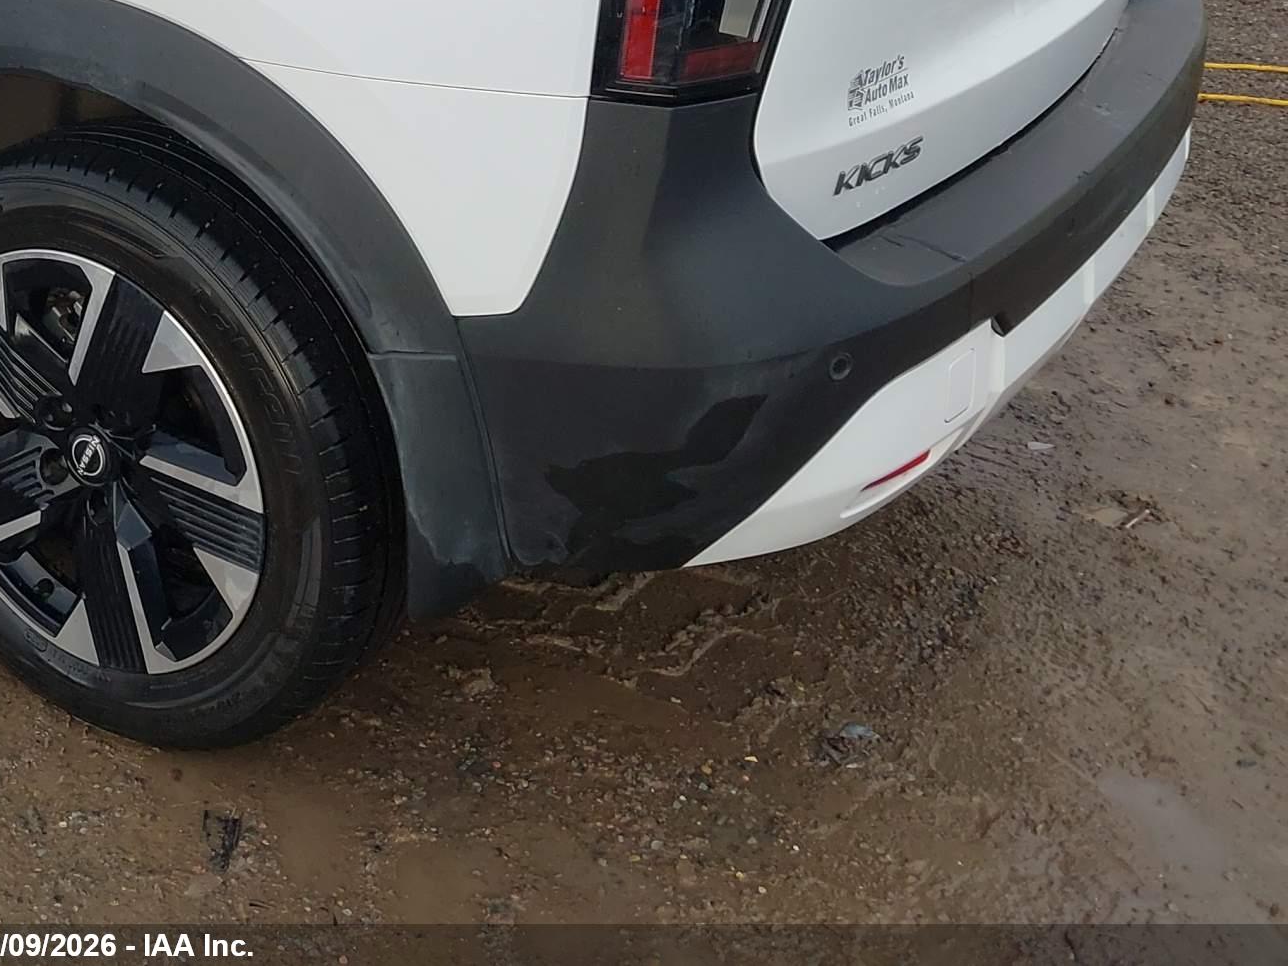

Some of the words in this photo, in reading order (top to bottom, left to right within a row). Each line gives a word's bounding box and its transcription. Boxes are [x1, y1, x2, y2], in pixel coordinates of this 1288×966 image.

[863, 54, 905, 86] Taylor's
[848, 111, 867, 127] Great
[833, 135, 924, 196] KICKS
